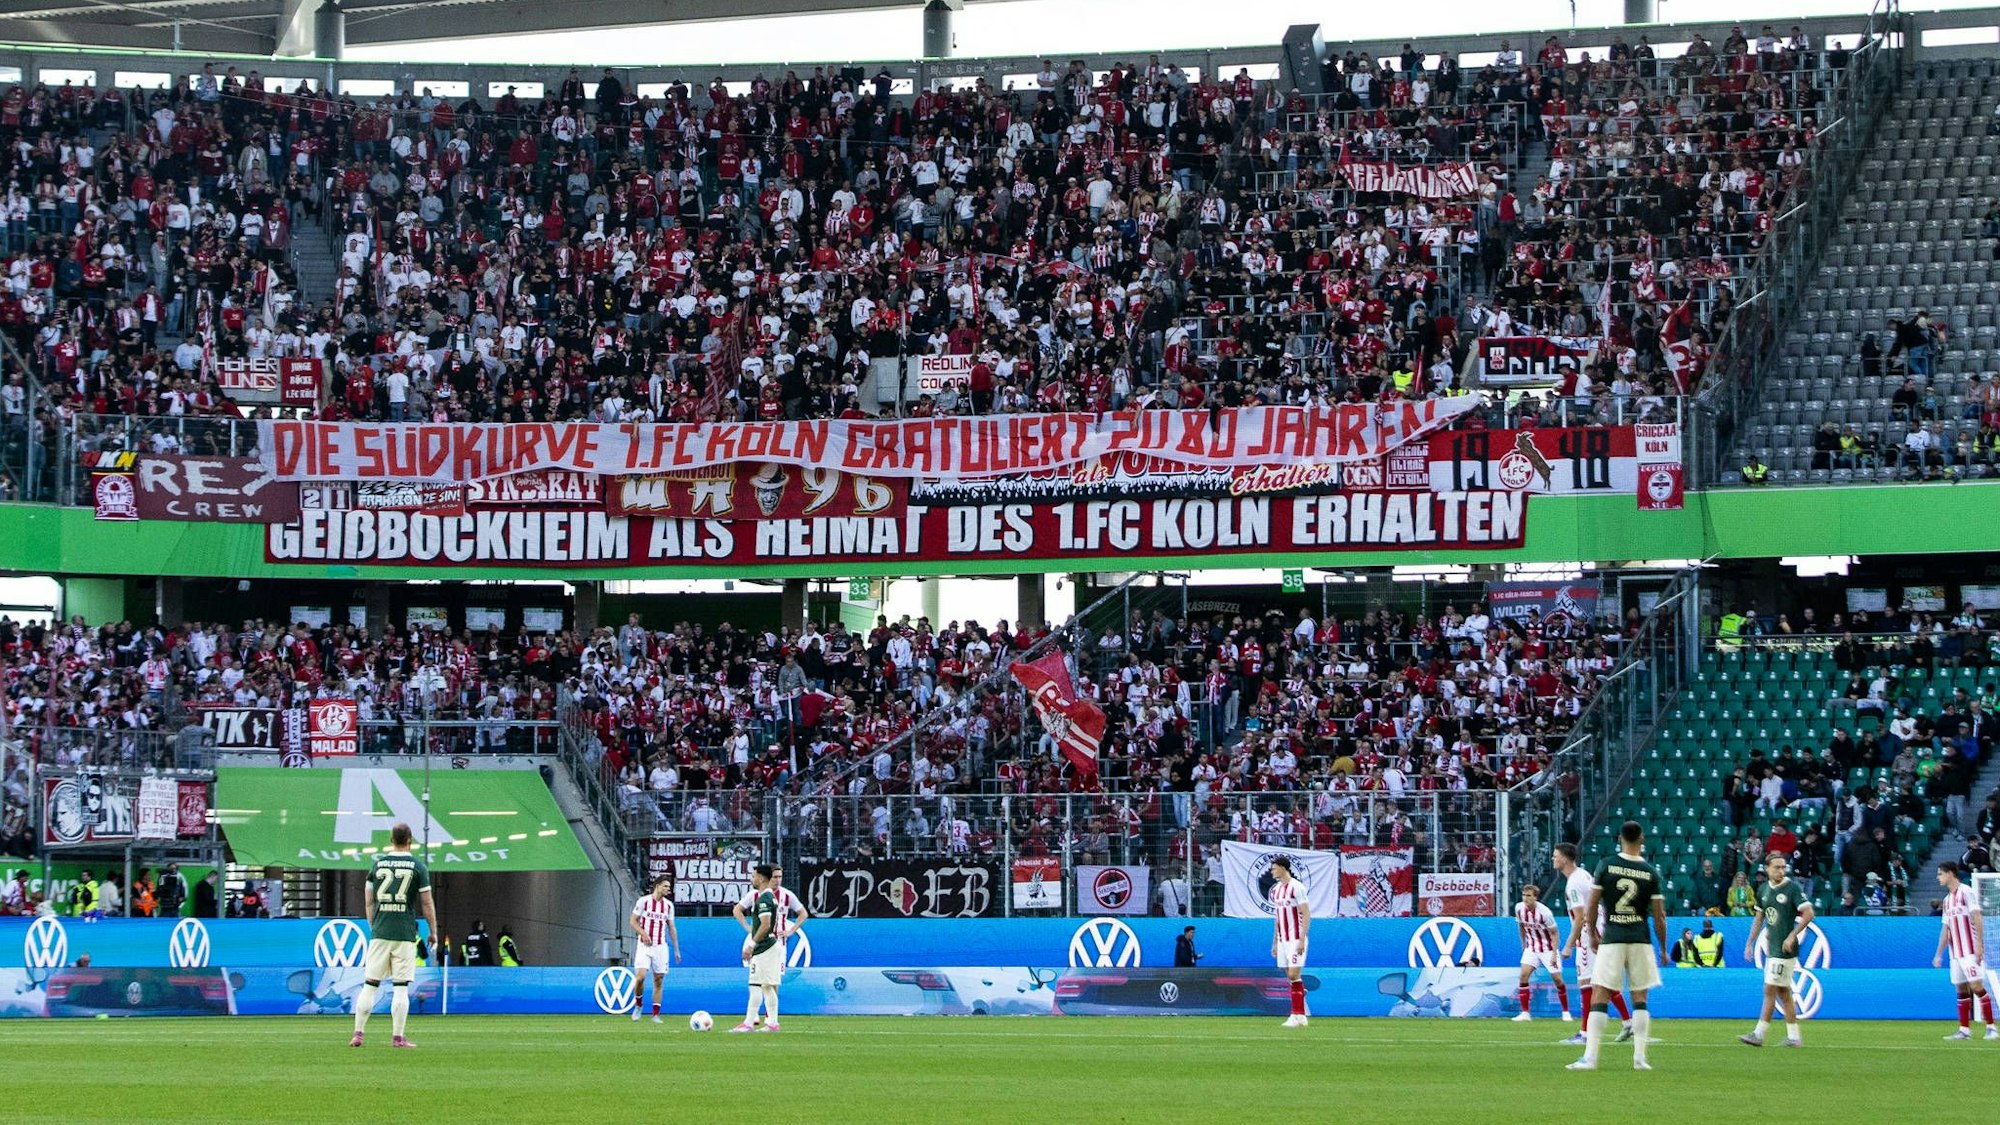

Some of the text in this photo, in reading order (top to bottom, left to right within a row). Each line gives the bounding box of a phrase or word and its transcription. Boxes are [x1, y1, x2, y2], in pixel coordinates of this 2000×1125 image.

[922, 358, 972, 370] REDLIN
[273, 422, 341, 477] DIE
[354, 422, 600, 482] SÜDKURVE
[619, 423, 696, 469] 1.FC
[706, 419, 829, 463] KÖLN
[842, 412, 1096, 473] GRATULIERT
[1175, 408, 1238, 458] 80
[1247, 400, 1436, 458] JAHREN
[1559, 430, 1613, 489] 48
[468, 472, 600, 500] SYNKAT
[1231, 462, 1331, 496] erhalten
[166, 500, 263, 518] CREW
[648, 517, 734, 558] ALS
[755, 505, 928, 556] HEIMAT
[948, 502, 1034, 552] DES
[1052, 500, 1141, 551] 1.FC
[1291, 490, 1524, 545] ERHALTEN
[851, 582, 869, 595] 33
[1283, 574, 1302, 587] 35
[311, 739, 357, 753] MALAD
[333, 768, 457, 845] A
[297, 847, 511, 864] AUTOTADT
[377, 860, 416, 869] WOLFSBURG
[1607, 864, 1652, 881] WOLFSBURG
[375, 867, 414, 903] 27
[1425, 879, 1491, 892] Ostböcke
[1614, 878, 1638, 915] 2
[379, 903, 406, 912] ARNOLD
